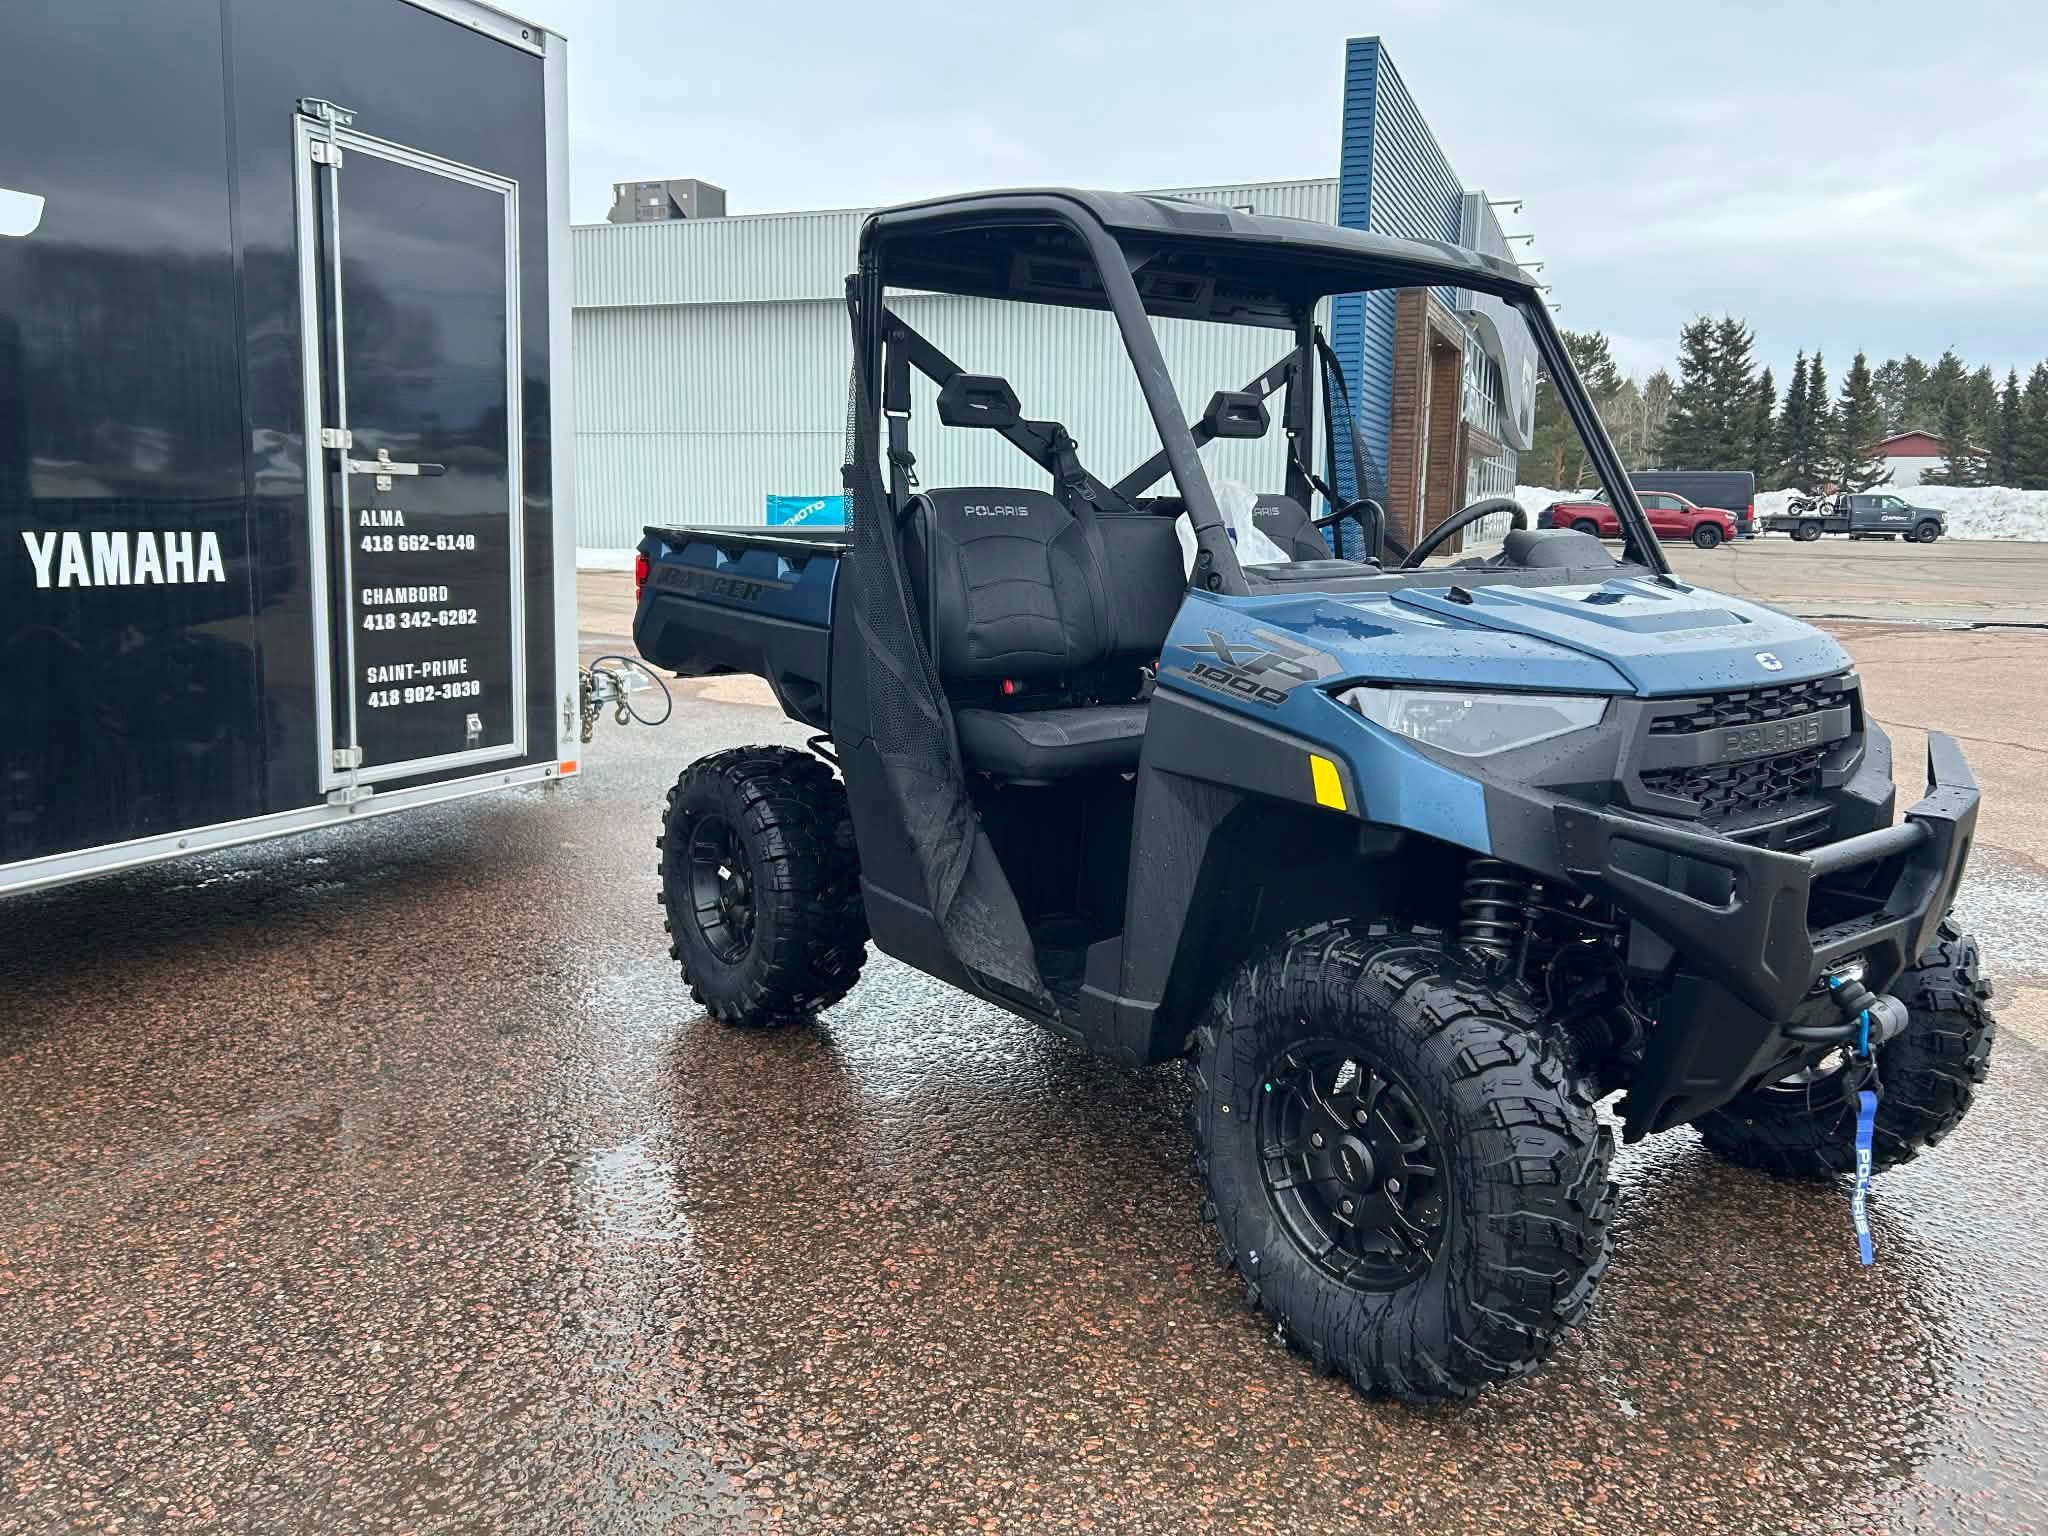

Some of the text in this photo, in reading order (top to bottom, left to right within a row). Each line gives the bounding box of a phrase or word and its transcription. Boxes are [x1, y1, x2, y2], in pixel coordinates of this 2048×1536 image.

[360, 509, 405, 527] ALMA
[963, 505, 1029, 517] POLARIS
[1254, 506, 1280, 516] ARIS
[361, 534, 475, 552] 418 662-6140
[22, 531, 226, 589] YAMAHA
[362, 585, 448, 605] CHAMBORD
[657, 567, 764, 601] RGER
[363, 608, 477, 631] 418 342-6202
[367, 658, 468, 684] SAINT-PRIME
[1190, 662, 1290, 705] 1000
[368, 680, 480, 708] 418 902-3030
[1722, 715, 1820, 757] POLARIS
[1855, 1149, 1870, 1235] POLARIS
